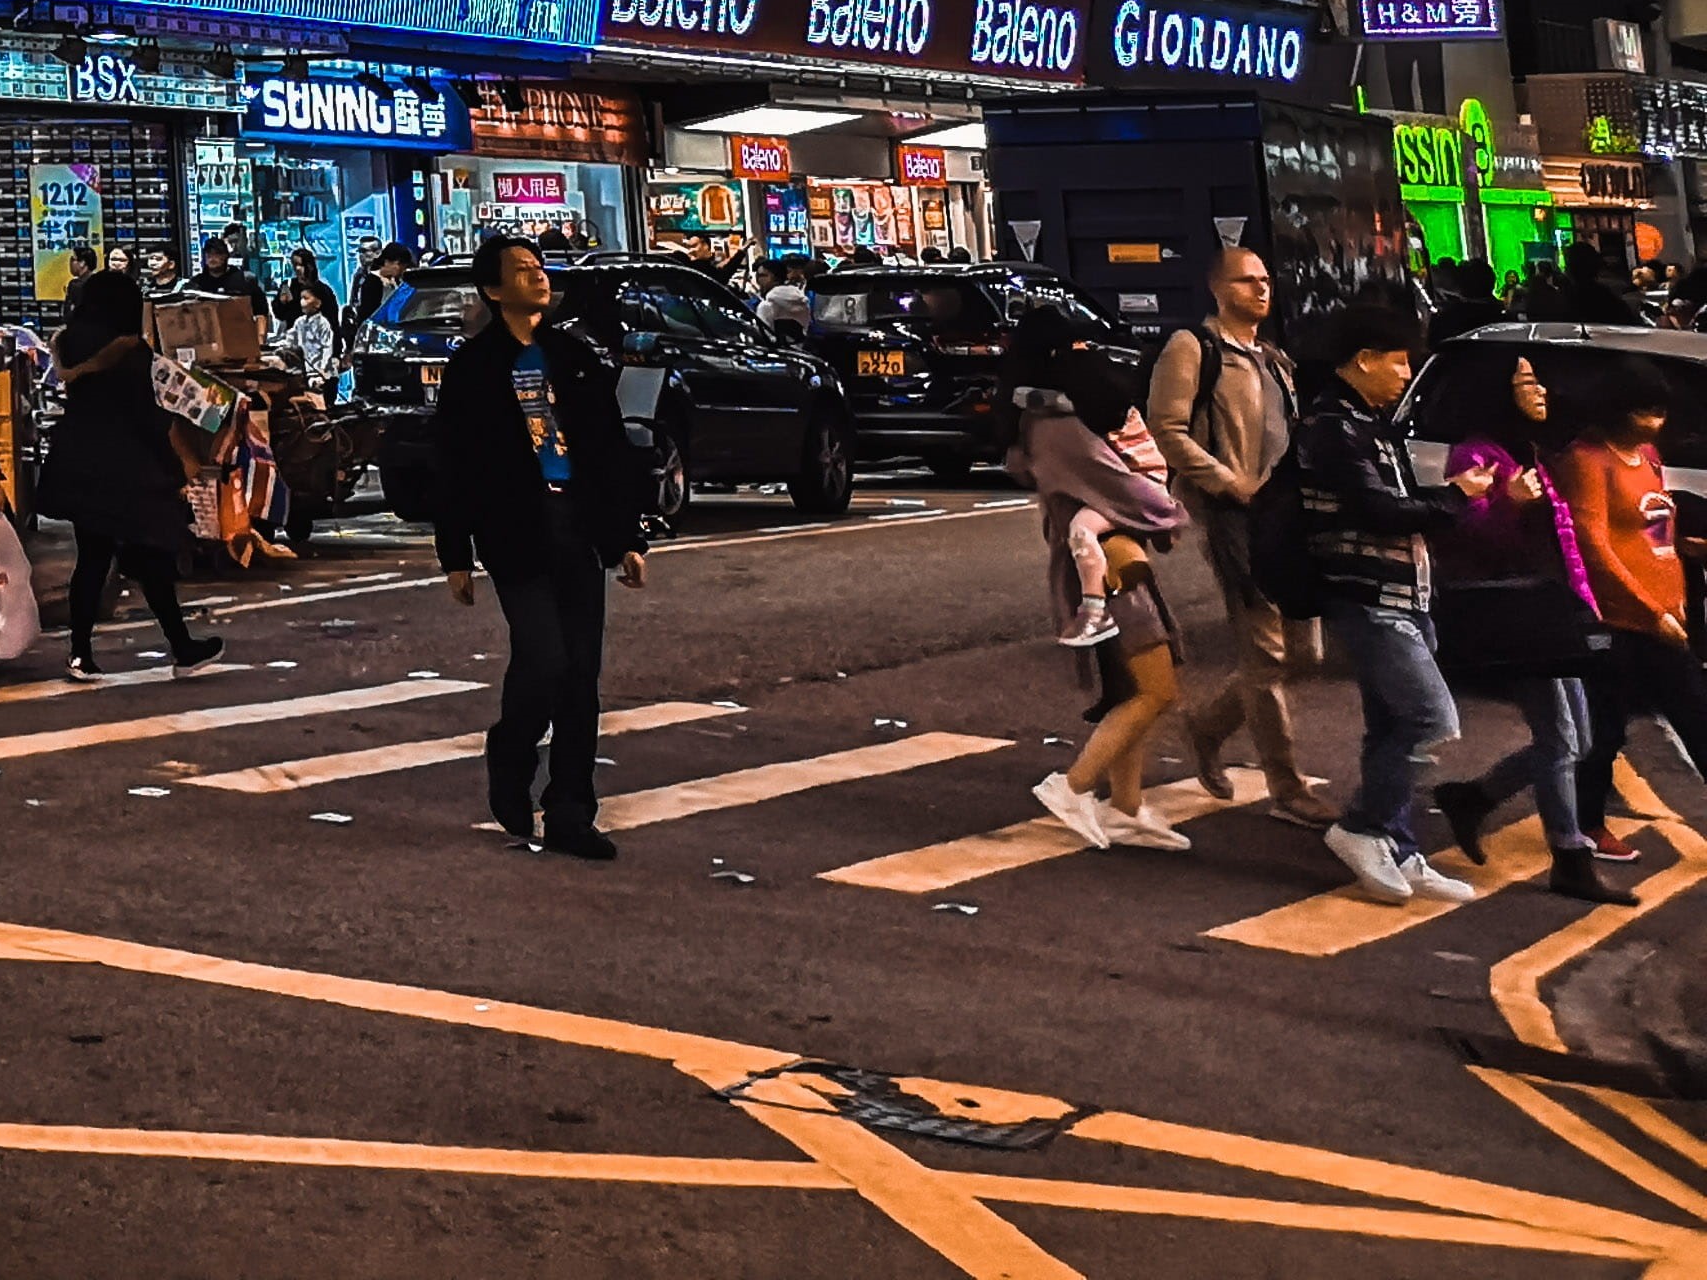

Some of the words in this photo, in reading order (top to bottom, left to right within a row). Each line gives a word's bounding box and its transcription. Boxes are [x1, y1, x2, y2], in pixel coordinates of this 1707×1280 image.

[1113, 0, 1300, 83] GIORDANO
[77, 56, 137, 101] BSX
[263, 79, 391, 134] SUNING
[529, 86, 607, 131] PHONE
[741, 143, 781, 171] Baleno
[904, 153, 939, 179] Baleno
[39, 182, 87, 206] 12.12
[861, 360, 901, 375] 2270
